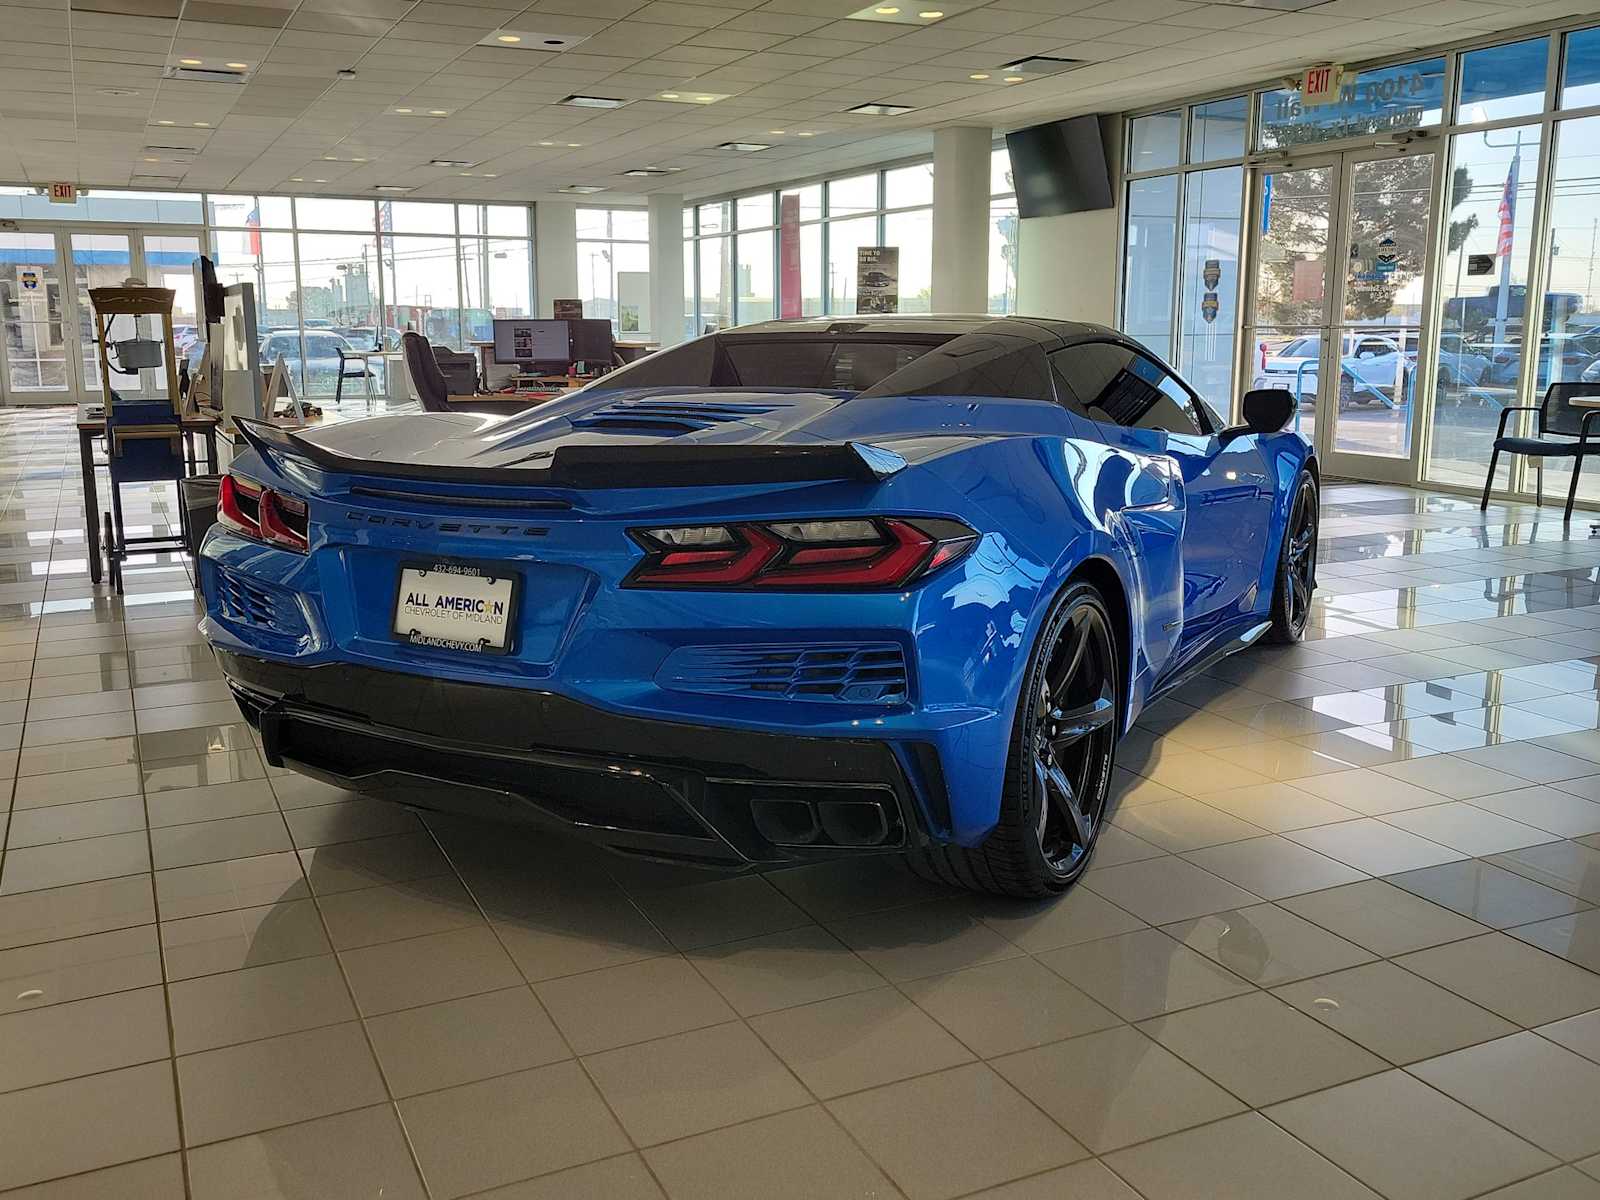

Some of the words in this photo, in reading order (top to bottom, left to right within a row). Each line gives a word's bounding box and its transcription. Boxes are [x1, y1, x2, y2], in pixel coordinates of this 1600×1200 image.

[1307, 69, 1331, 95] EXIT
[54, 184, 72, 198] EXIT
[346, 511, 550, 536] CORVETTE
[433, 564, 481, 577] 432-694-9601
[405, 592, 429, 607] ALL
[404, 605, 451, 619] CHEVROLET
[452, 611, 464, 620] OF
[465, 613, 503, 625] MIDLAND
[410, 634, 482, 653] MIDLANDCHEVY.COM
